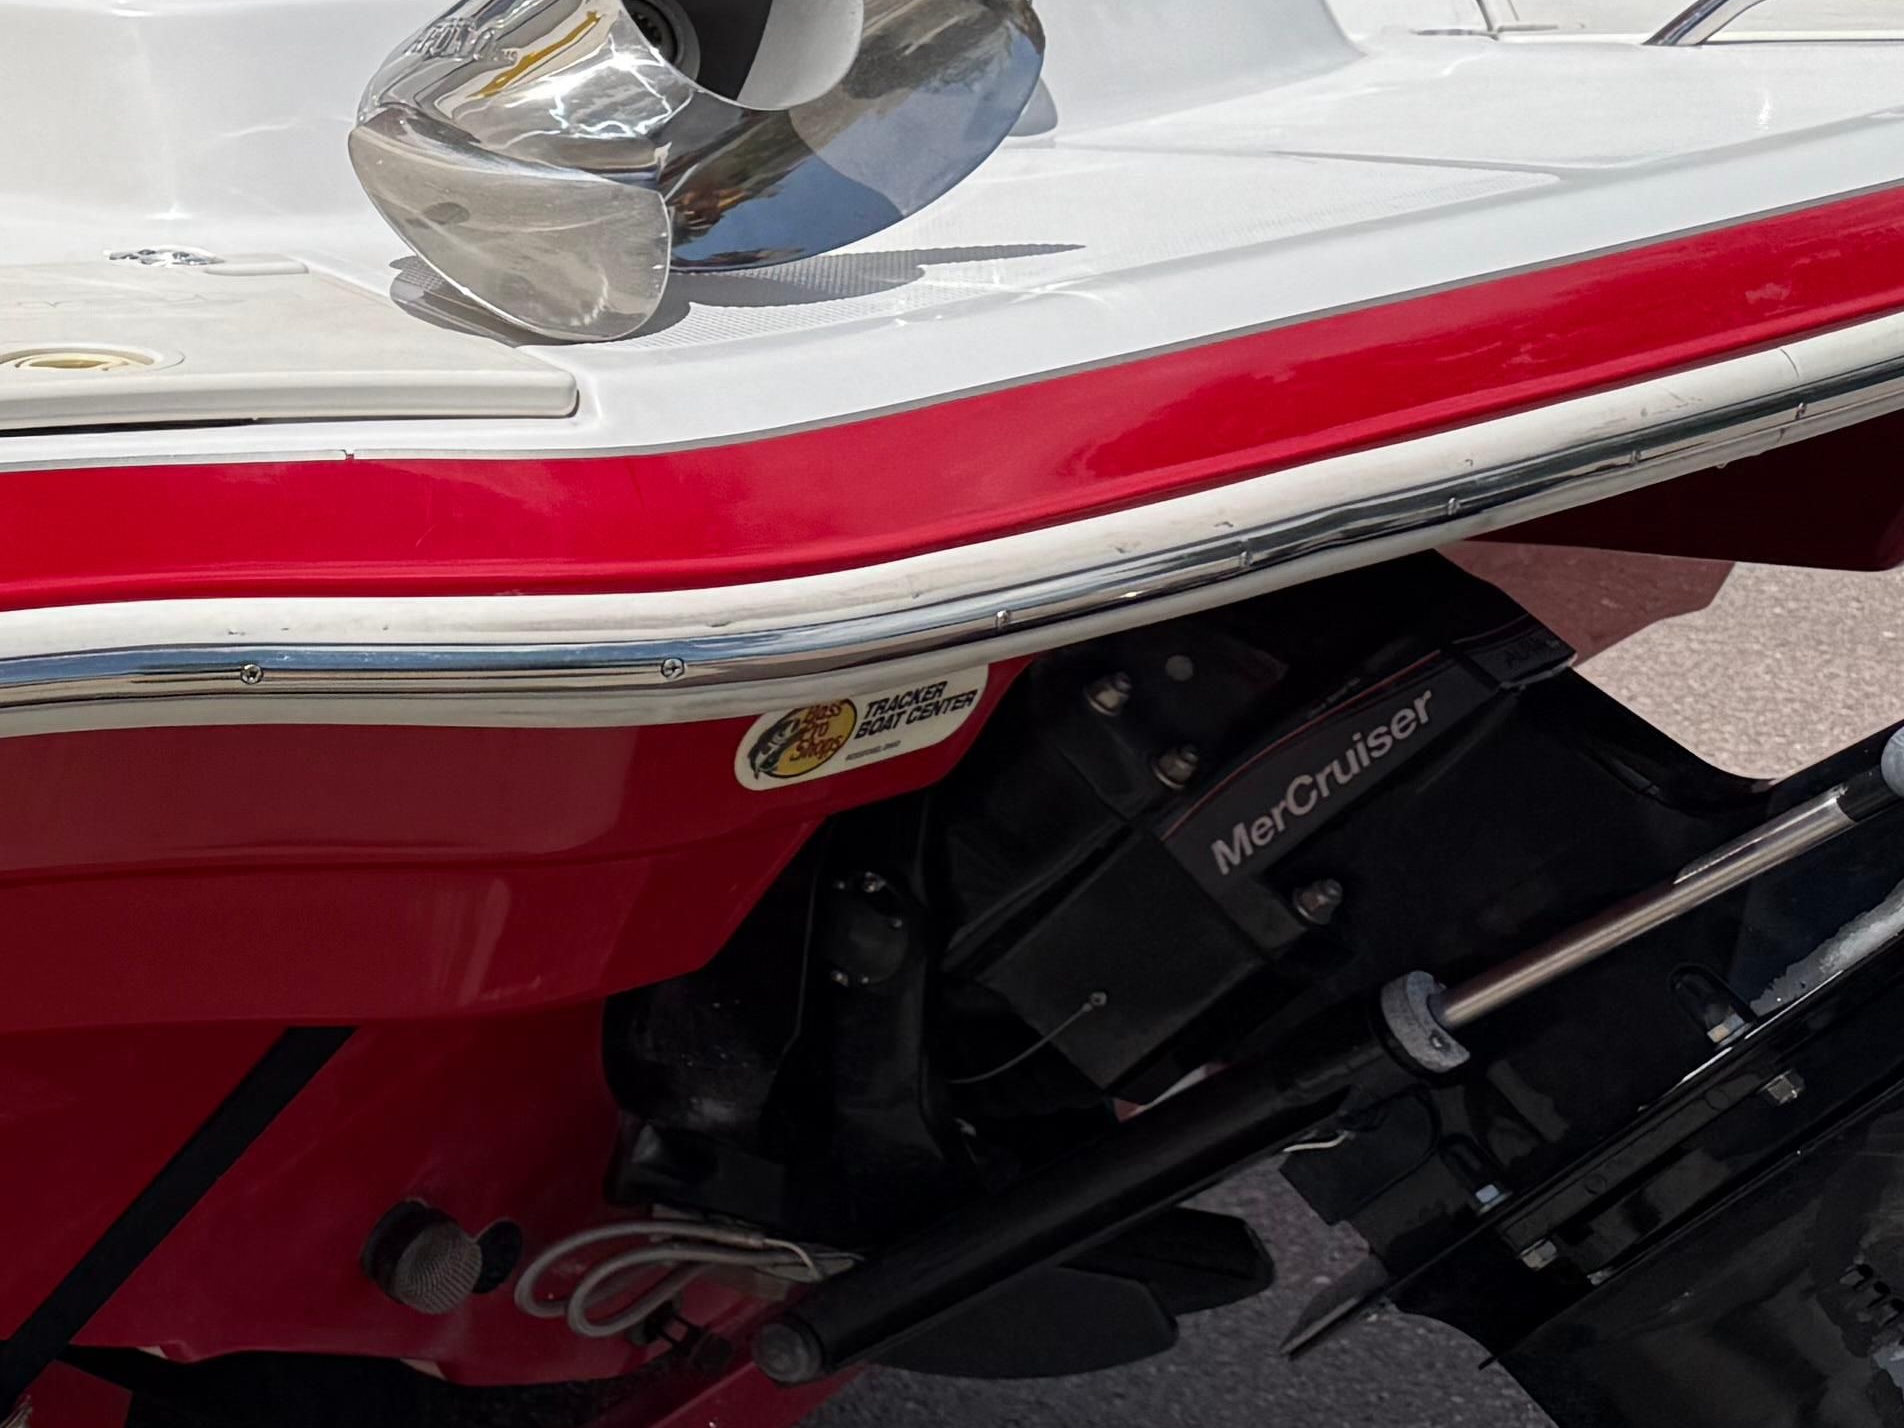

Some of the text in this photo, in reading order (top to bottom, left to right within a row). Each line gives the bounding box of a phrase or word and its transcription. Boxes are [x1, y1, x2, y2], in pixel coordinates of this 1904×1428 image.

[854, 689, 978, 739] BOAT CENTER
[863, 680, 948, 719] TRACKER
[789, 735, 843, 762] Shops
[1210, 689, 1433, 876] MerCruiser
